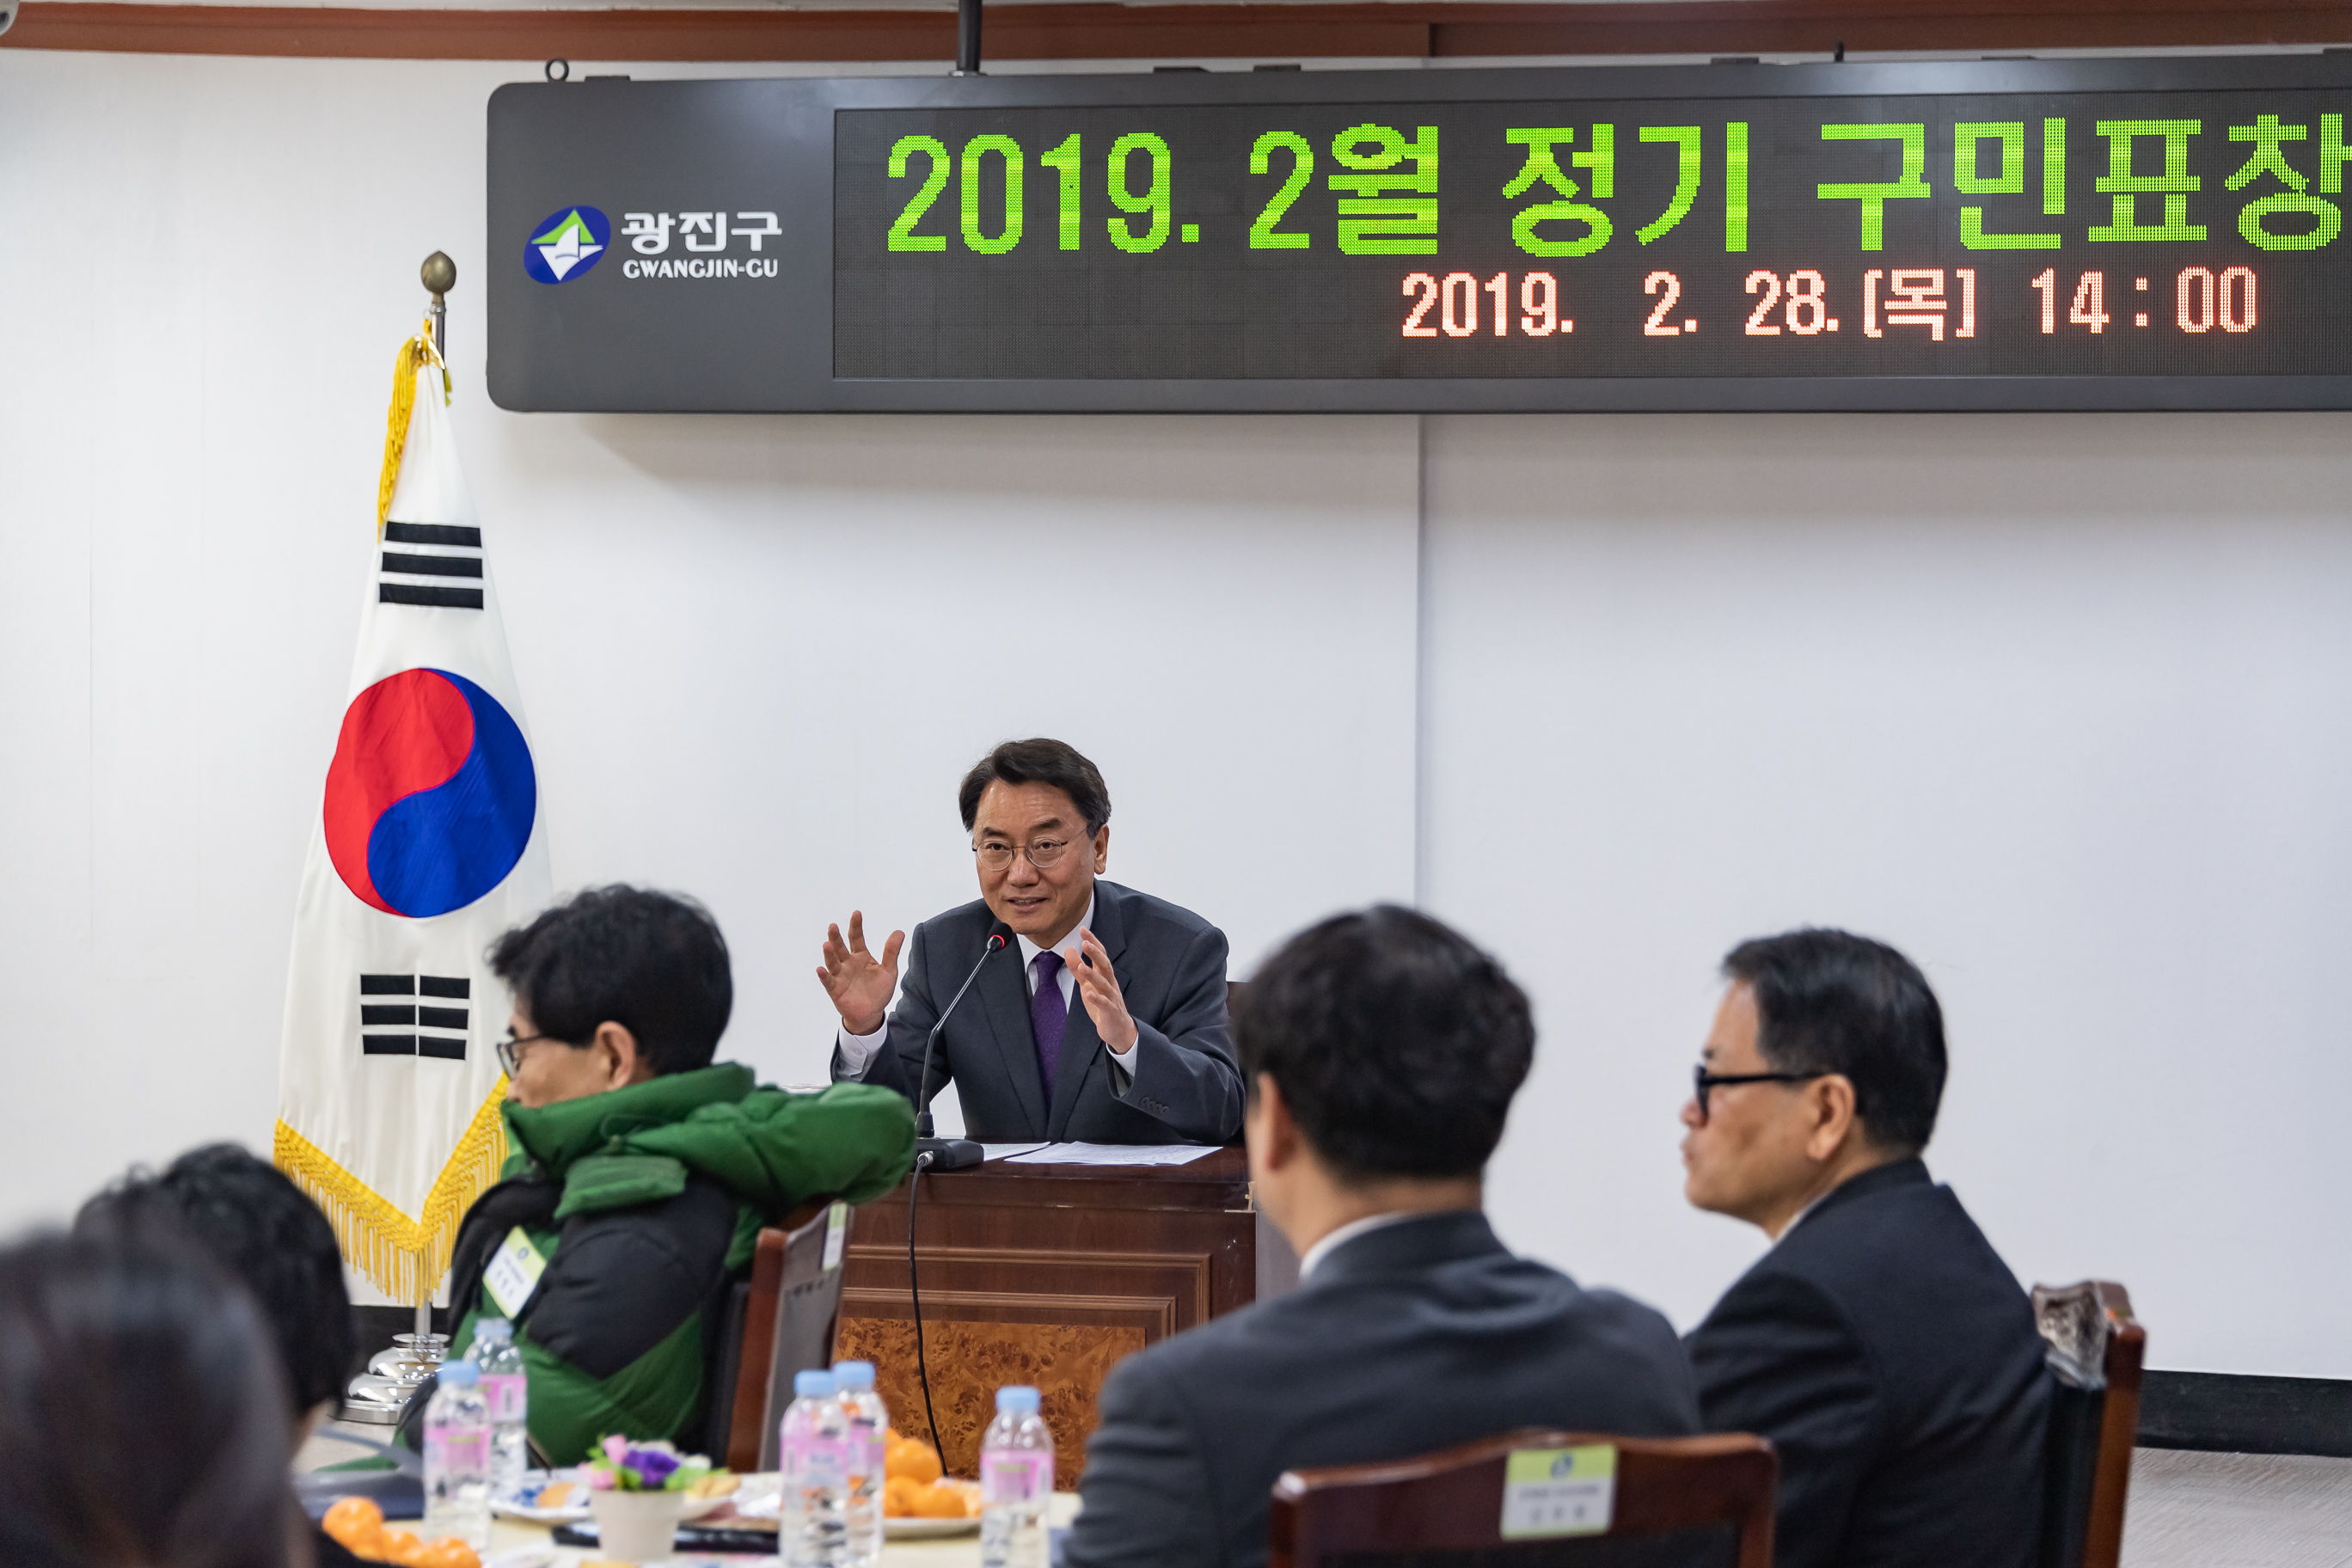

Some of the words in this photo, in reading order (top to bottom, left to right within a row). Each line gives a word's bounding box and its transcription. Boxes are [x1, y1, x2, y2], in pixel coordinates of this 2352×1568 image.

[887, 132, 1199, 254] 2019.
[1249, 123, 1438, 255] 2월
[1502, 122, 1748, 257] 정기
[1816, 113, 2352, 251] 구민표창
[621, 211, 783, 255] 광진구
[622, 258, 779, 279] GWANGJIN-GU
[1401, 271, 1574, 337] 2019.
[1644, 270, 1698, 336] 2.
